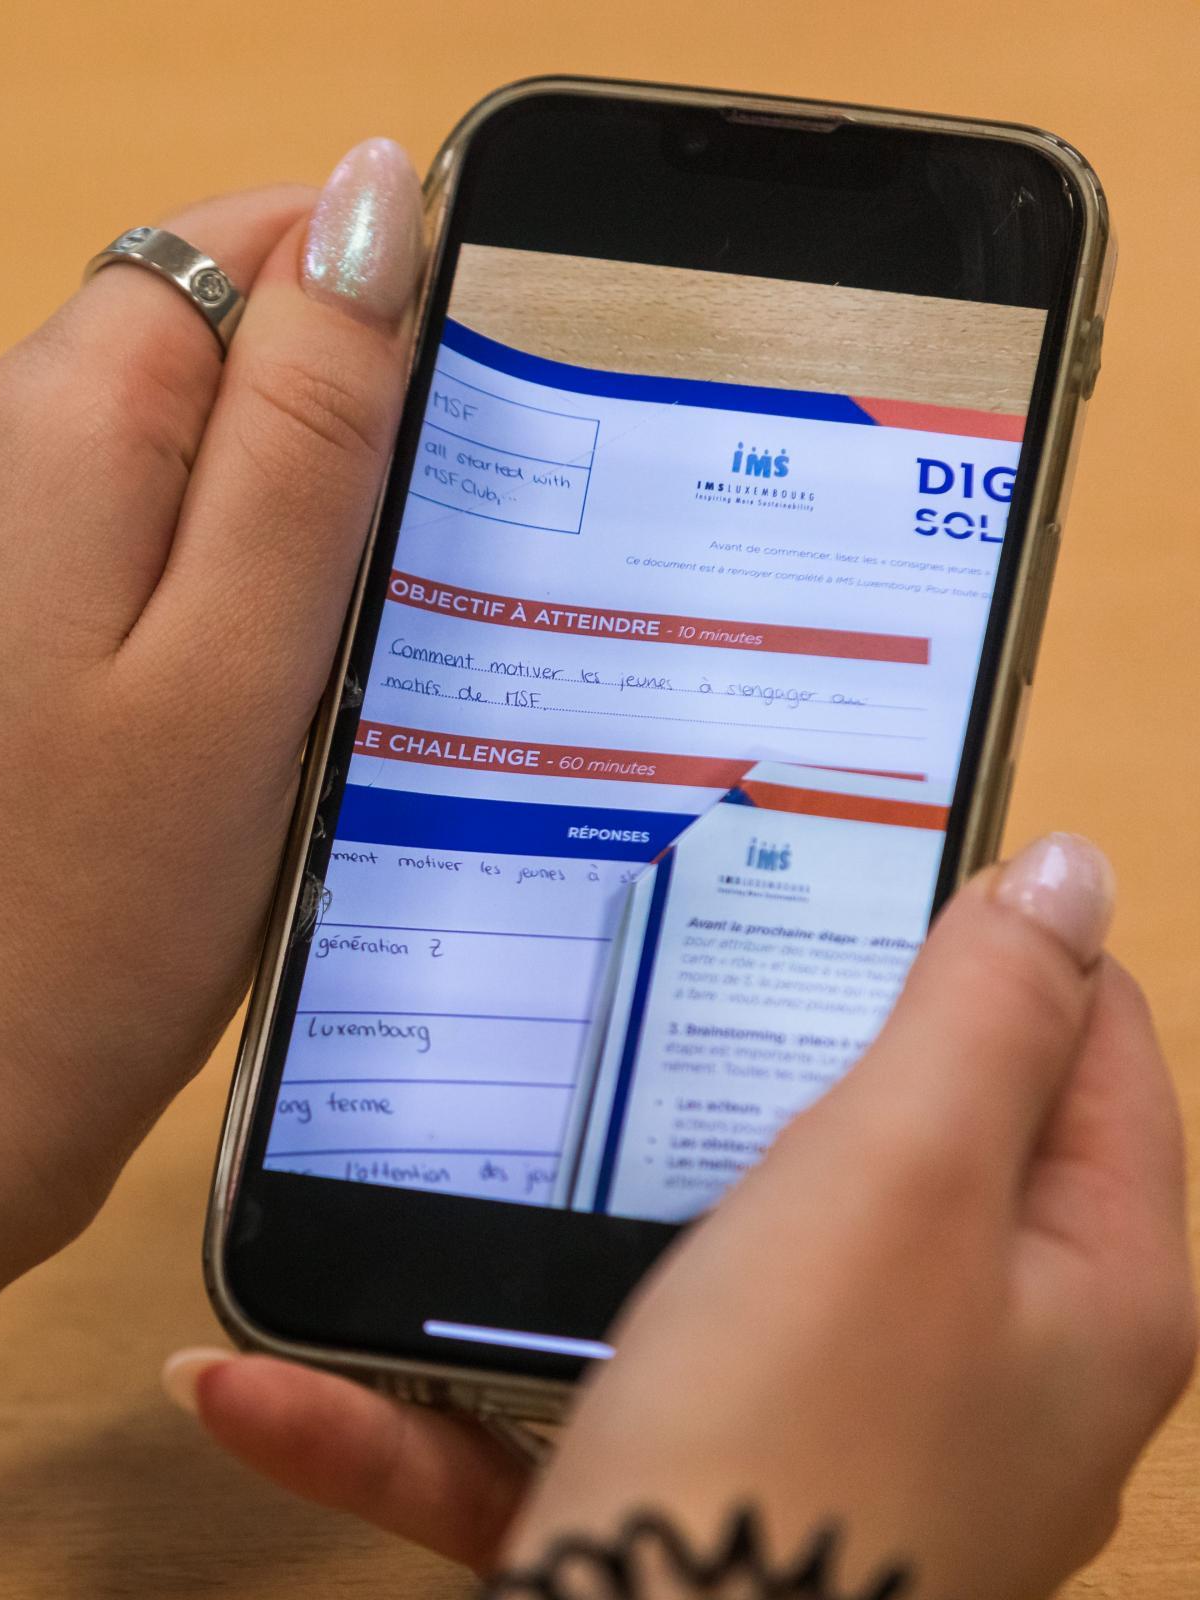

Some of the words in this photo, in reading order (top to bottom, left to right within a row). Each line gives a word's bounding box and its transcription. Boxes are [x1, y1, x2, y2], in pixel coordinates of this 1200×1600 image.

[433, 391, 478, 420] MSF
[424, 441, 447, 459] all
[456, 452, 524, 480] started
[532, 474, 570, 489] with
[424, 464, 459, 485] MSF
[914, 508, 1004, 544] SOL
[709, 540, 743, 553] Avant
[745, 546, 761, 554] de
[625, 555, 640, 566] Ce
[642, 558, 697, 571] document
[699, 564, 715, 573] est
[727, 567, 774, 579] renvoyer
[835, 576, 856, 585] IMS
[391, 579, 505, 617] OBJECTIF
[510, 602, 527, 622] À
[533, 610, 661, 636] ATTEINDRE
[677, 625, 696, 640] 10
[699, 629, 764, 646] minutes
[390, 638, 475, 669] Comment
[490, 661, 565, 681] motiver
[581, 669, 601, 684] les
[619, 673, 674, 692] jeunes
[698, 676, 713, 694] à
[386, 675, 442, 696] motifs
[458, 685, 488, 703] de
[506, 689, 542, 709] MSF
[389, 734, 541, 768] CHALLENGE
[558, 756, 584, 770] 60
[587, 760, 657, 777] minutes
[567, 825, 651, 844] RÉPONSES
[398, 855, 463, 872] motiver
[480, 861, 501, 875] les
[516, 867, 566, 884] jeunes
[588, 864, 600, 881] à
[316, 936, 409, 958] génération
[308, 1017, 431, 1053] Luxembourg
[326, 1092, 394, 1115] terme
